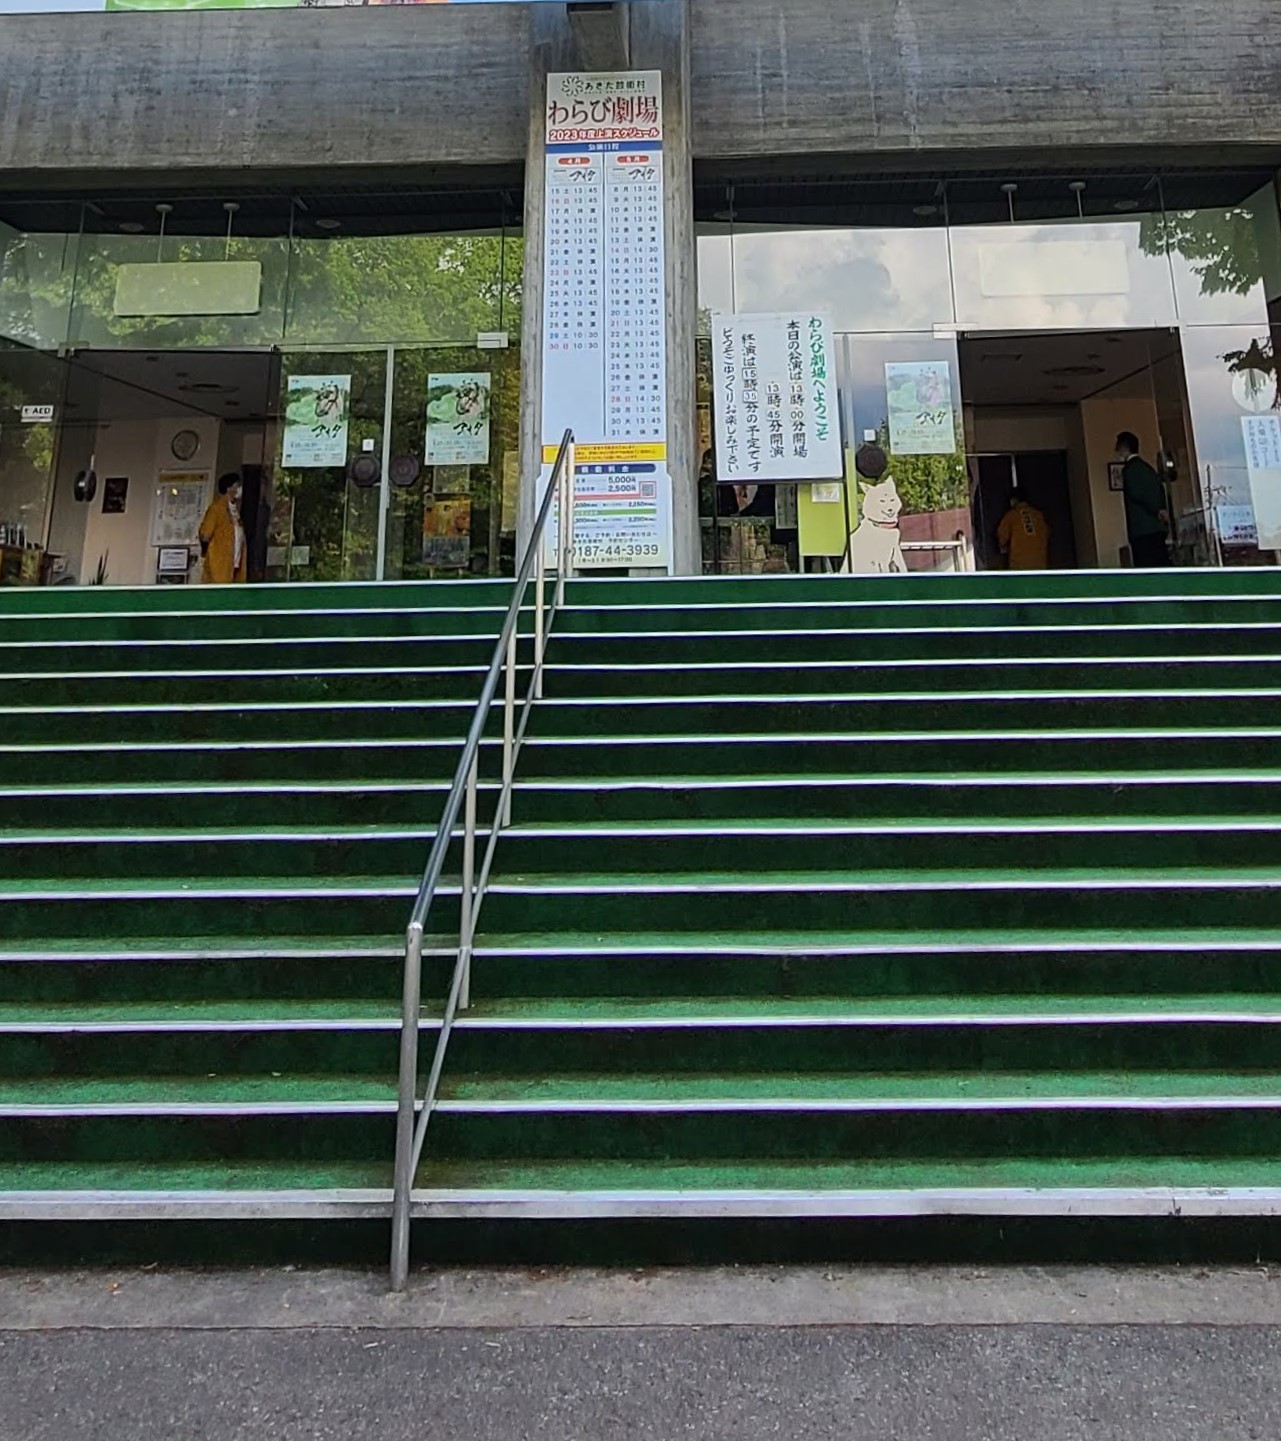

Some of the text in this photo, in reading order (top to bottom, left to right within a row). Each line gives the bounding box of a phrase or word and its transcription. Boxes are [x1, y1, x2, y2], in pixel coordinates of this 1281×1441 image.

[548, 96, 658, 125] わらび劇場
[549, 127, 660, 141] 2023年度上演スケジュール
[808, 317, 829, 441] わらび劇場へようこそ
